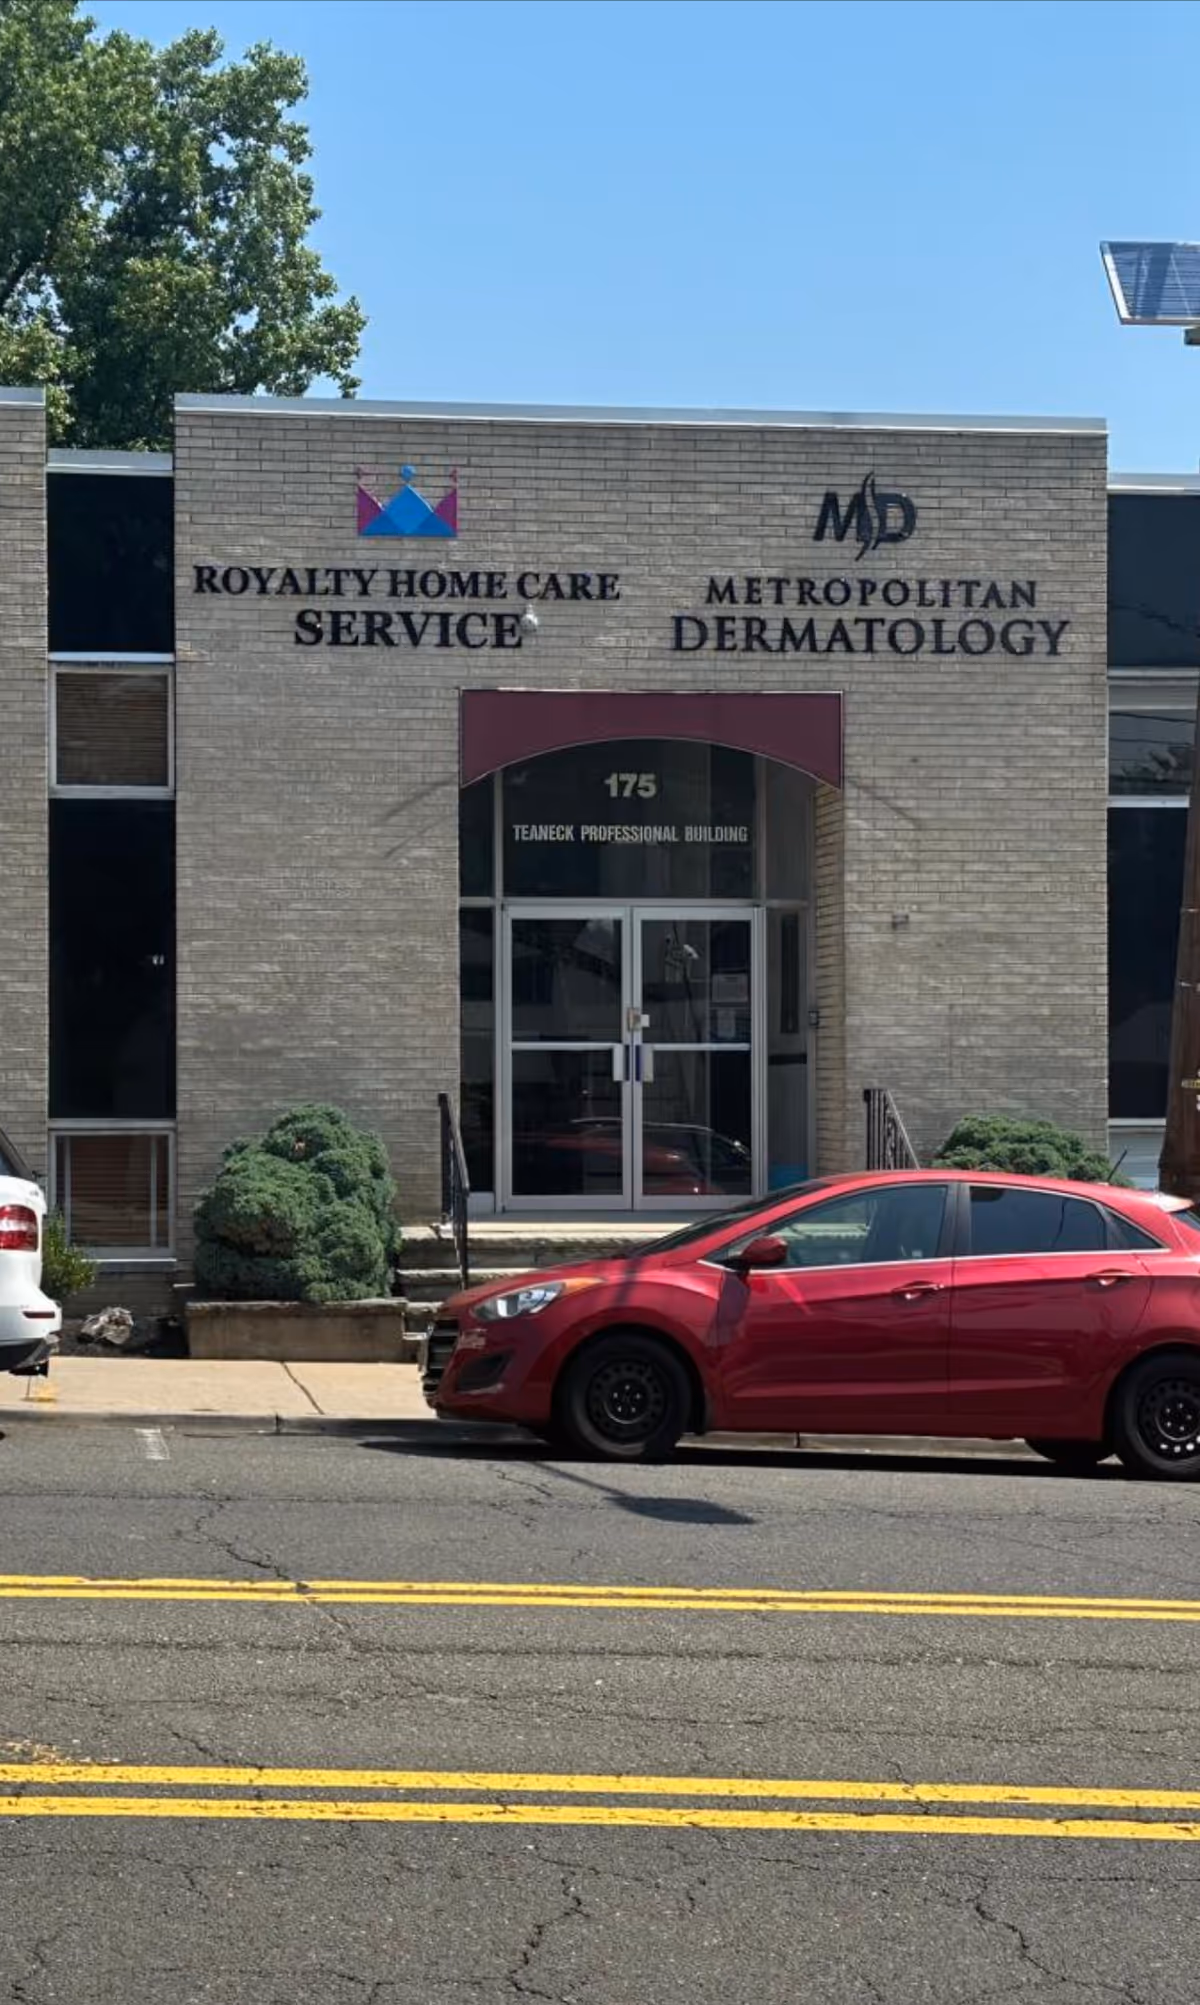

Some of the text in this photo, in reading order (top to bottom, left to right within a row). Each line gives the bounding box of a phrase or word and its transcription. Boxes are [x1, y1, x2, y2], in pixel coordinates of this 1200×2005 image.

[193, 565, 621, 601] ROYALTY HOME CARE
[705, 576, 1037, 608] METROPOLITAN
[294, 608, 524, 649] SERVICE
[671, 614, 1070, 656] DERMATOLOGY
[604, 773, 657, 797] 175
[513, 824, 748, 842] TEANECK PROFESSIONAL BUILDING
